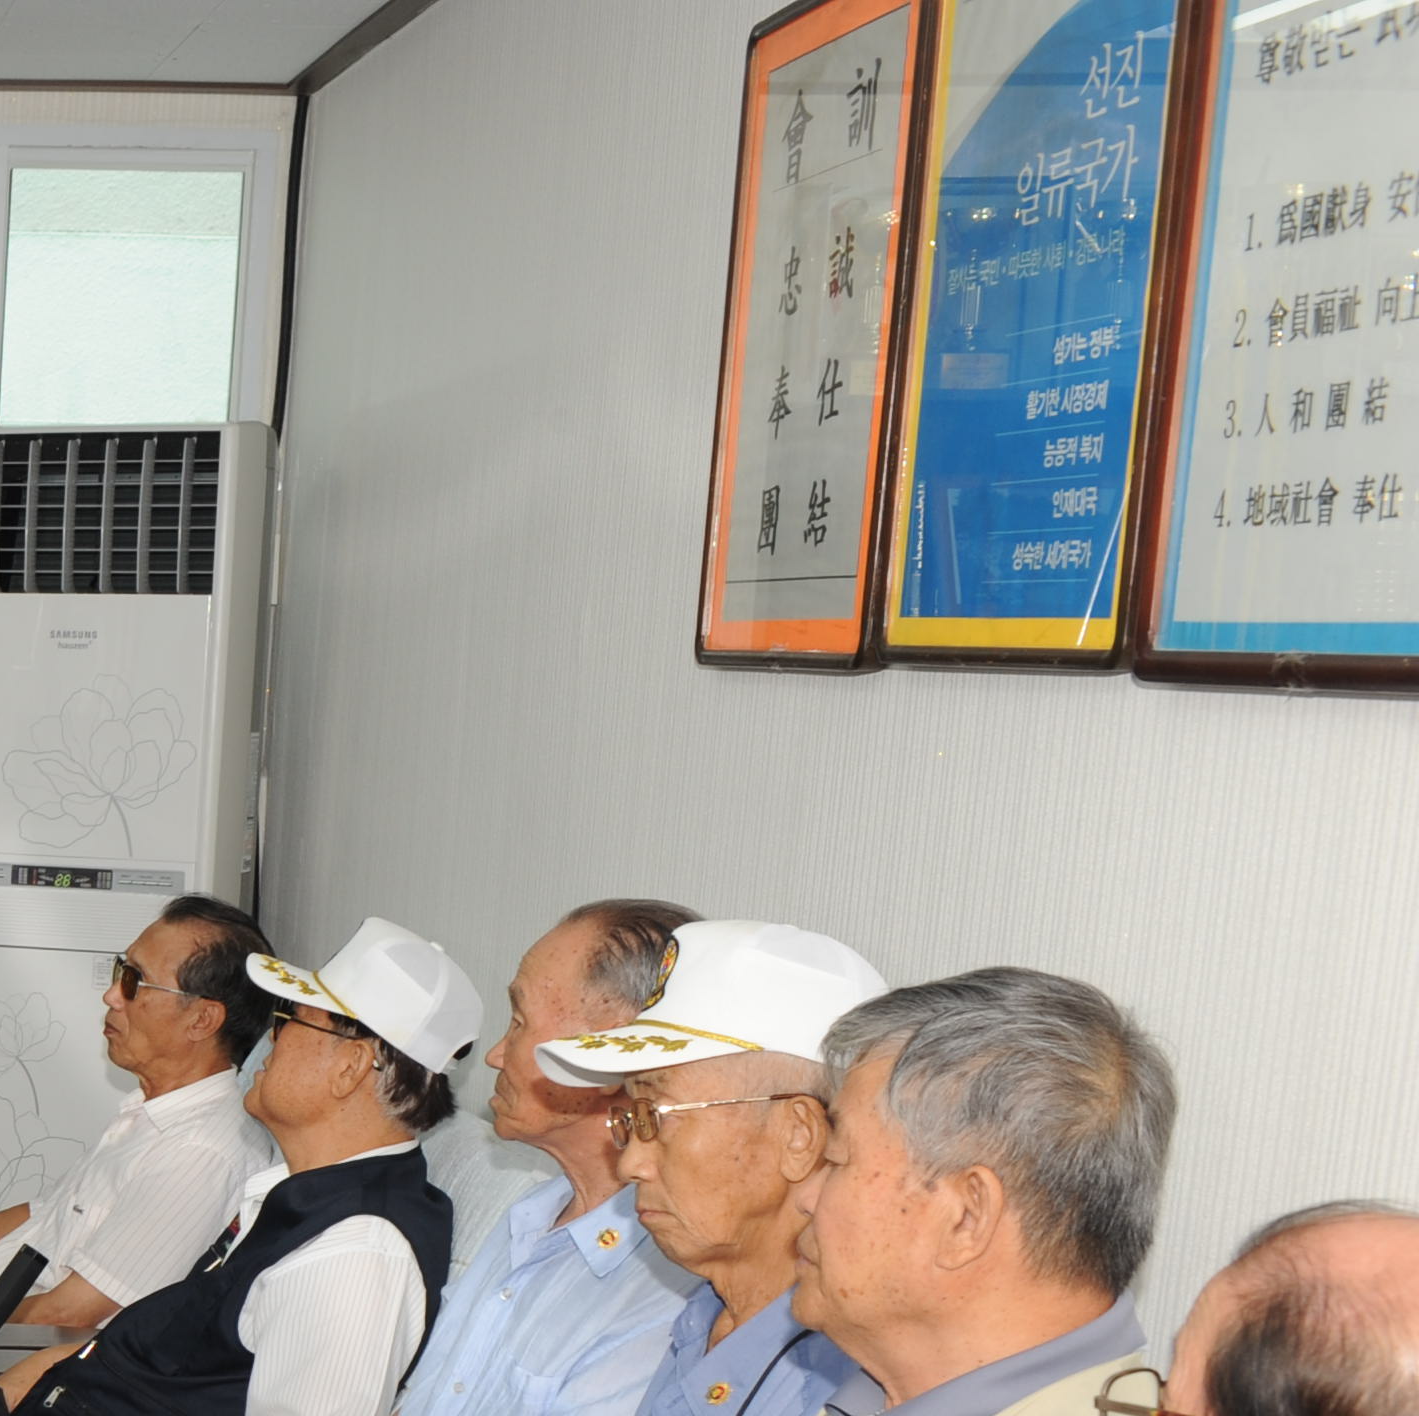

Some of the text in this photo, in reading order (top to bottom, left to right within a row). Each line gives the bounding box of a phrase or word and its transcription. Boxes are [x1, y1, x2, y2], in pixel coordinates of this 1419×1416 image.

[1080, 30, 1144, 119] 선진
[1017, 124, 1138, 225] 일류국가
[1244, 212, 1262, 252] 1.
[1054, 325, 1115, 365] 섬기는 정부
[1232, 308, 1251, 348] 2.
[1026, 380, 1109, 420] 활기찬 시장경제
[1224, 400, 1242, 439] 3.
[1044, 432, 1104, 468] 능동적 복지
[1053, 487, 1098, 518] 인재대국
[1214, 473, 1403, 528] 4. 地域社會 奉仕
[1012, 540, 1093, 571] 성숙한 세계국가
